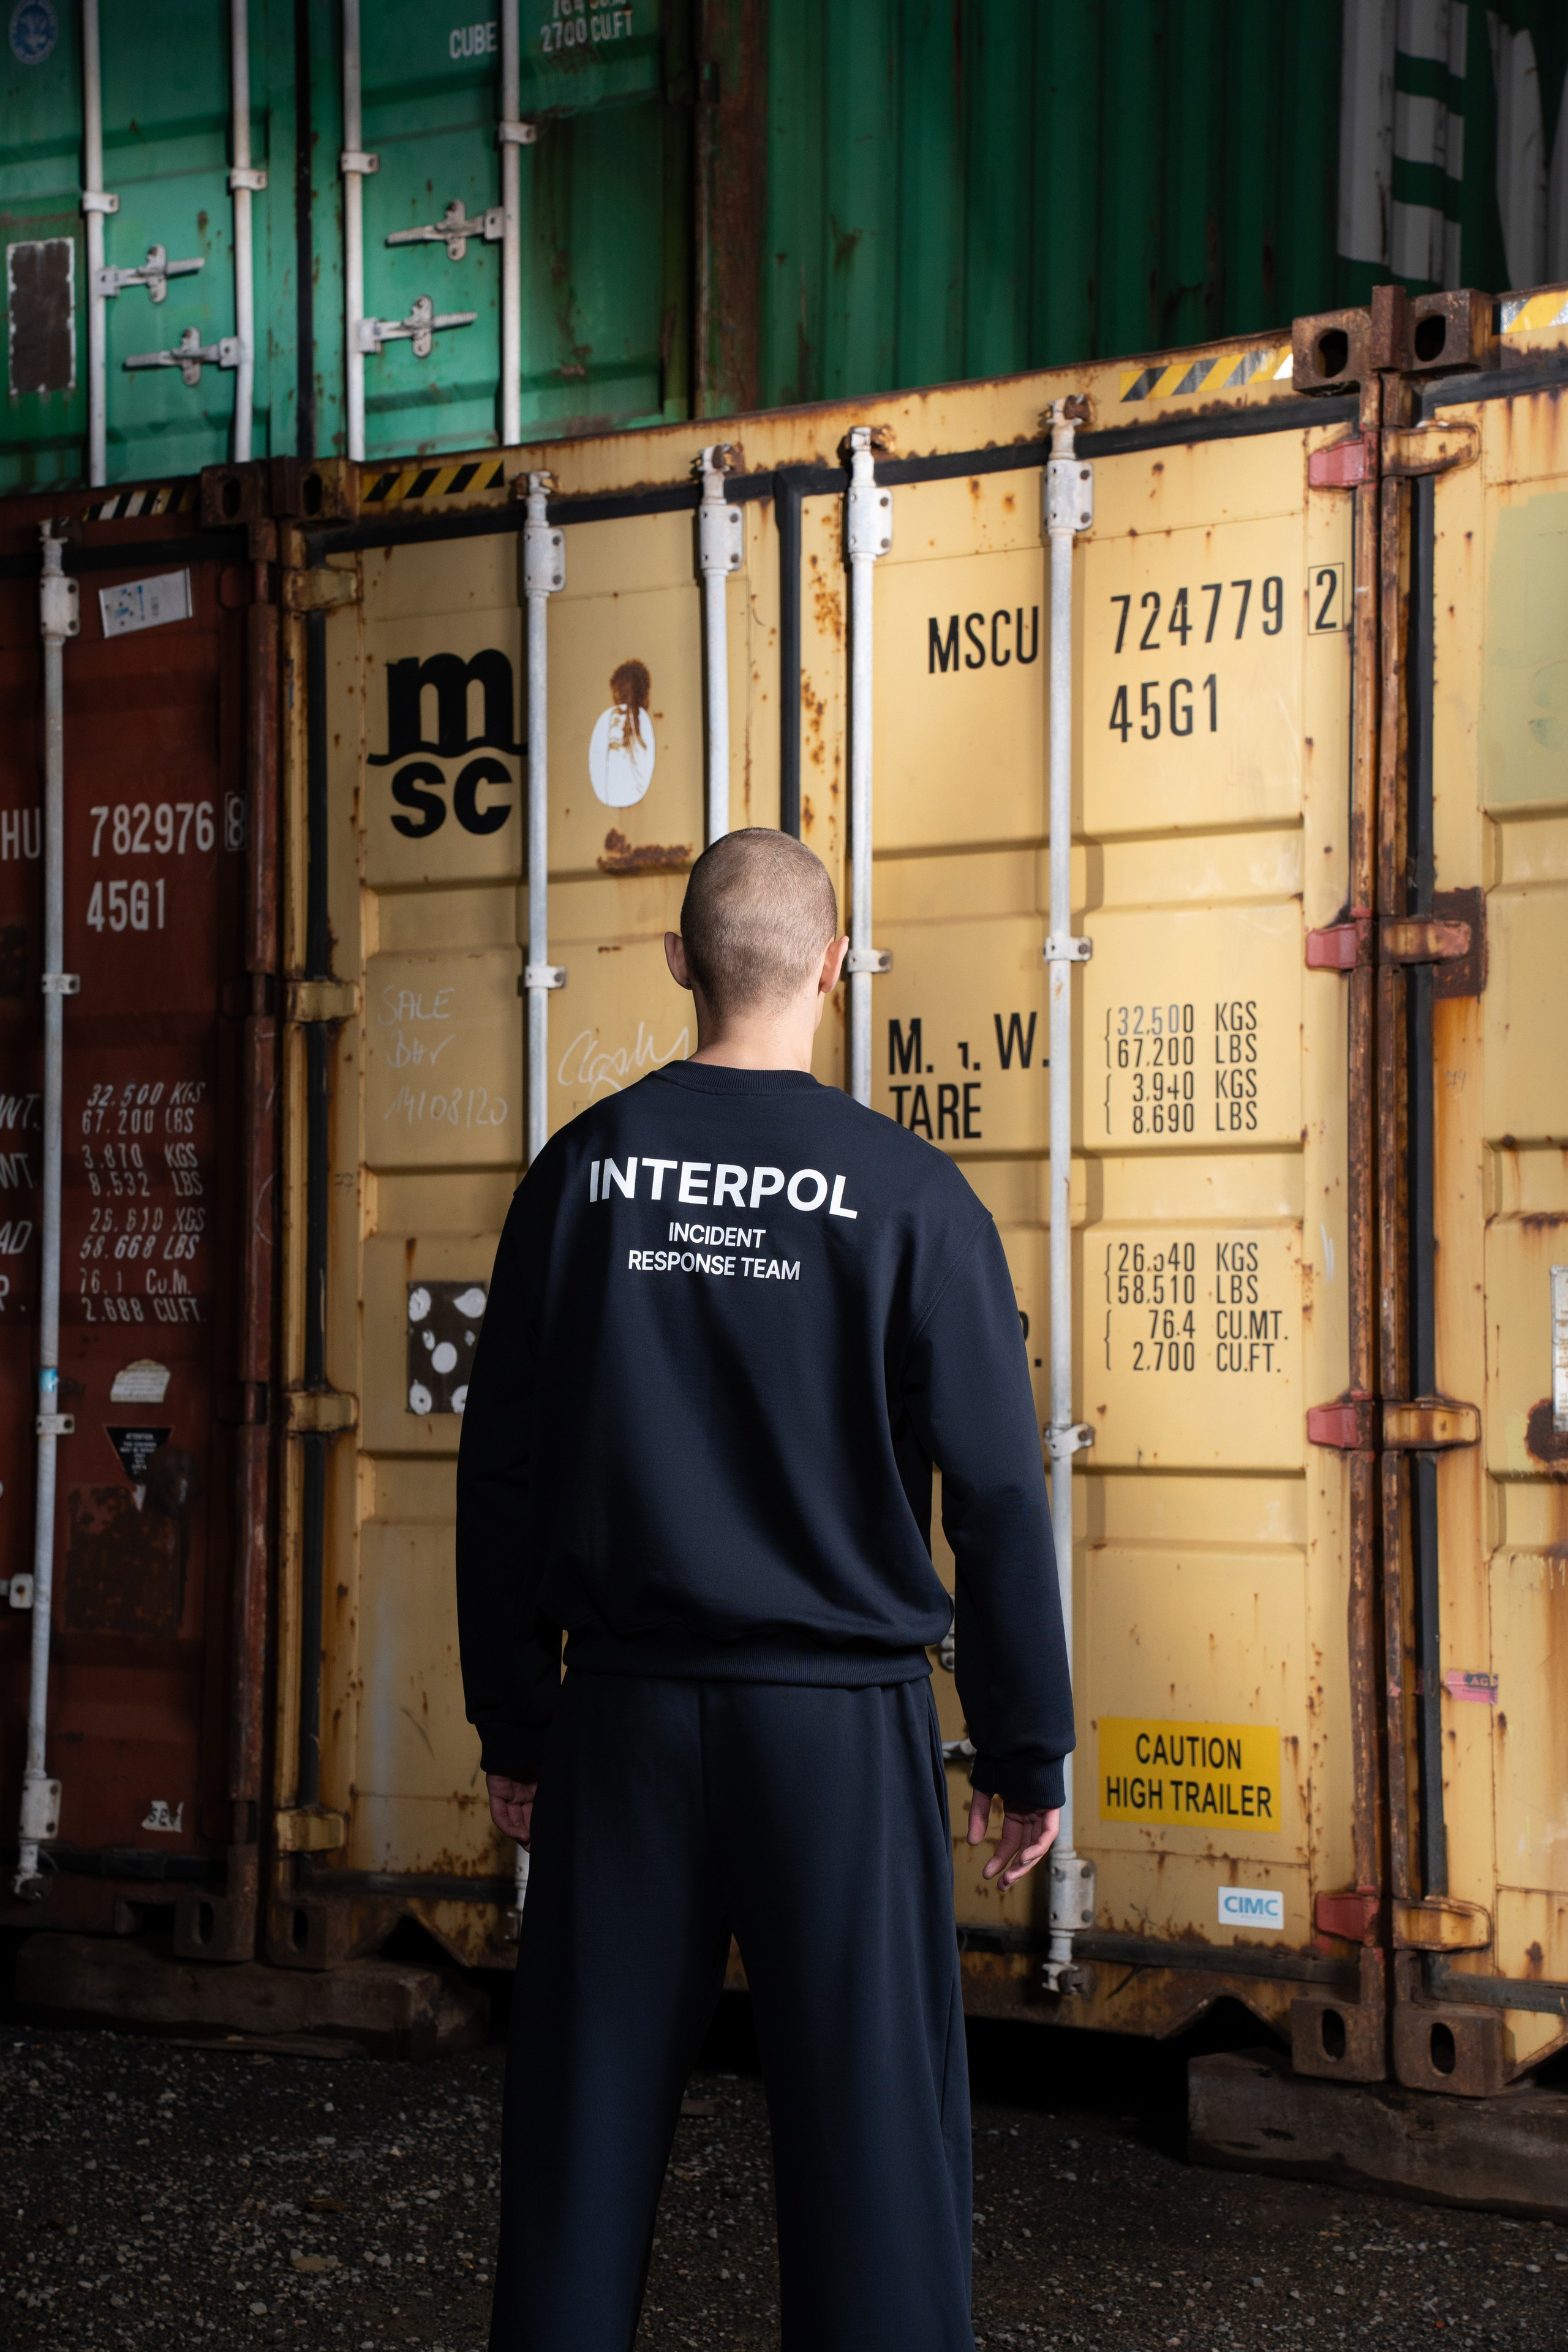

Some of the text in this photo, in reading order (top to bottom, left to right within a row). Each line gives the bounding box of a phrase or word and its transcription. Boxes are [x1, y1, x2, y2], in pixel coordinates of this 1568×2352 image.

[449, 20, 499, 60] CUBE
[540, 17, 587, 53] 2700
[928, 568, 1338, 674] MSCU 724779 2
[1109, 673, 1218, 743] 45G1
[1, 807, 41, 861] HU
[89, 799, 215, 858] 782976
[86, 877, 166, 933] 45G1
[377, 984, 455, 1027] SALE
[1215, 1001, 1257, 1031] KGS
[1215, 1033, 1257, 1063] LBS
[169, 1081, 206, 1105] KGS
[889, 1081, 982, 1140] TARE
[1215, 1068, 1257, 1098] KGS
[165, 1107, 195, 1134] LBS
[1215, 1101, 1257, 1131] LBS
[164, 1142, 199, 1168] KGS
[171, 1170, 204, 1197] LBS
[590, 1156, 858, 1219] INTERPOL
[162, 1233, 201, 1261] LBS
[669, 1221, 766, 1248] INCIDENT
[628, 1250, 801, 1281] RESPONSE TEAM
[1216, 1242, 1258, 1272] KGS
[1216, 1275, 1258, 1304] LBS
[1148, 1310, 1196, 1339] 76.4
[1136, 1733, 1242, 1770] CAUTION
[1106, 1776, 1272, 1818] HIGH TRAILER
[1224, 1896, 1278, 1917] CIMC
